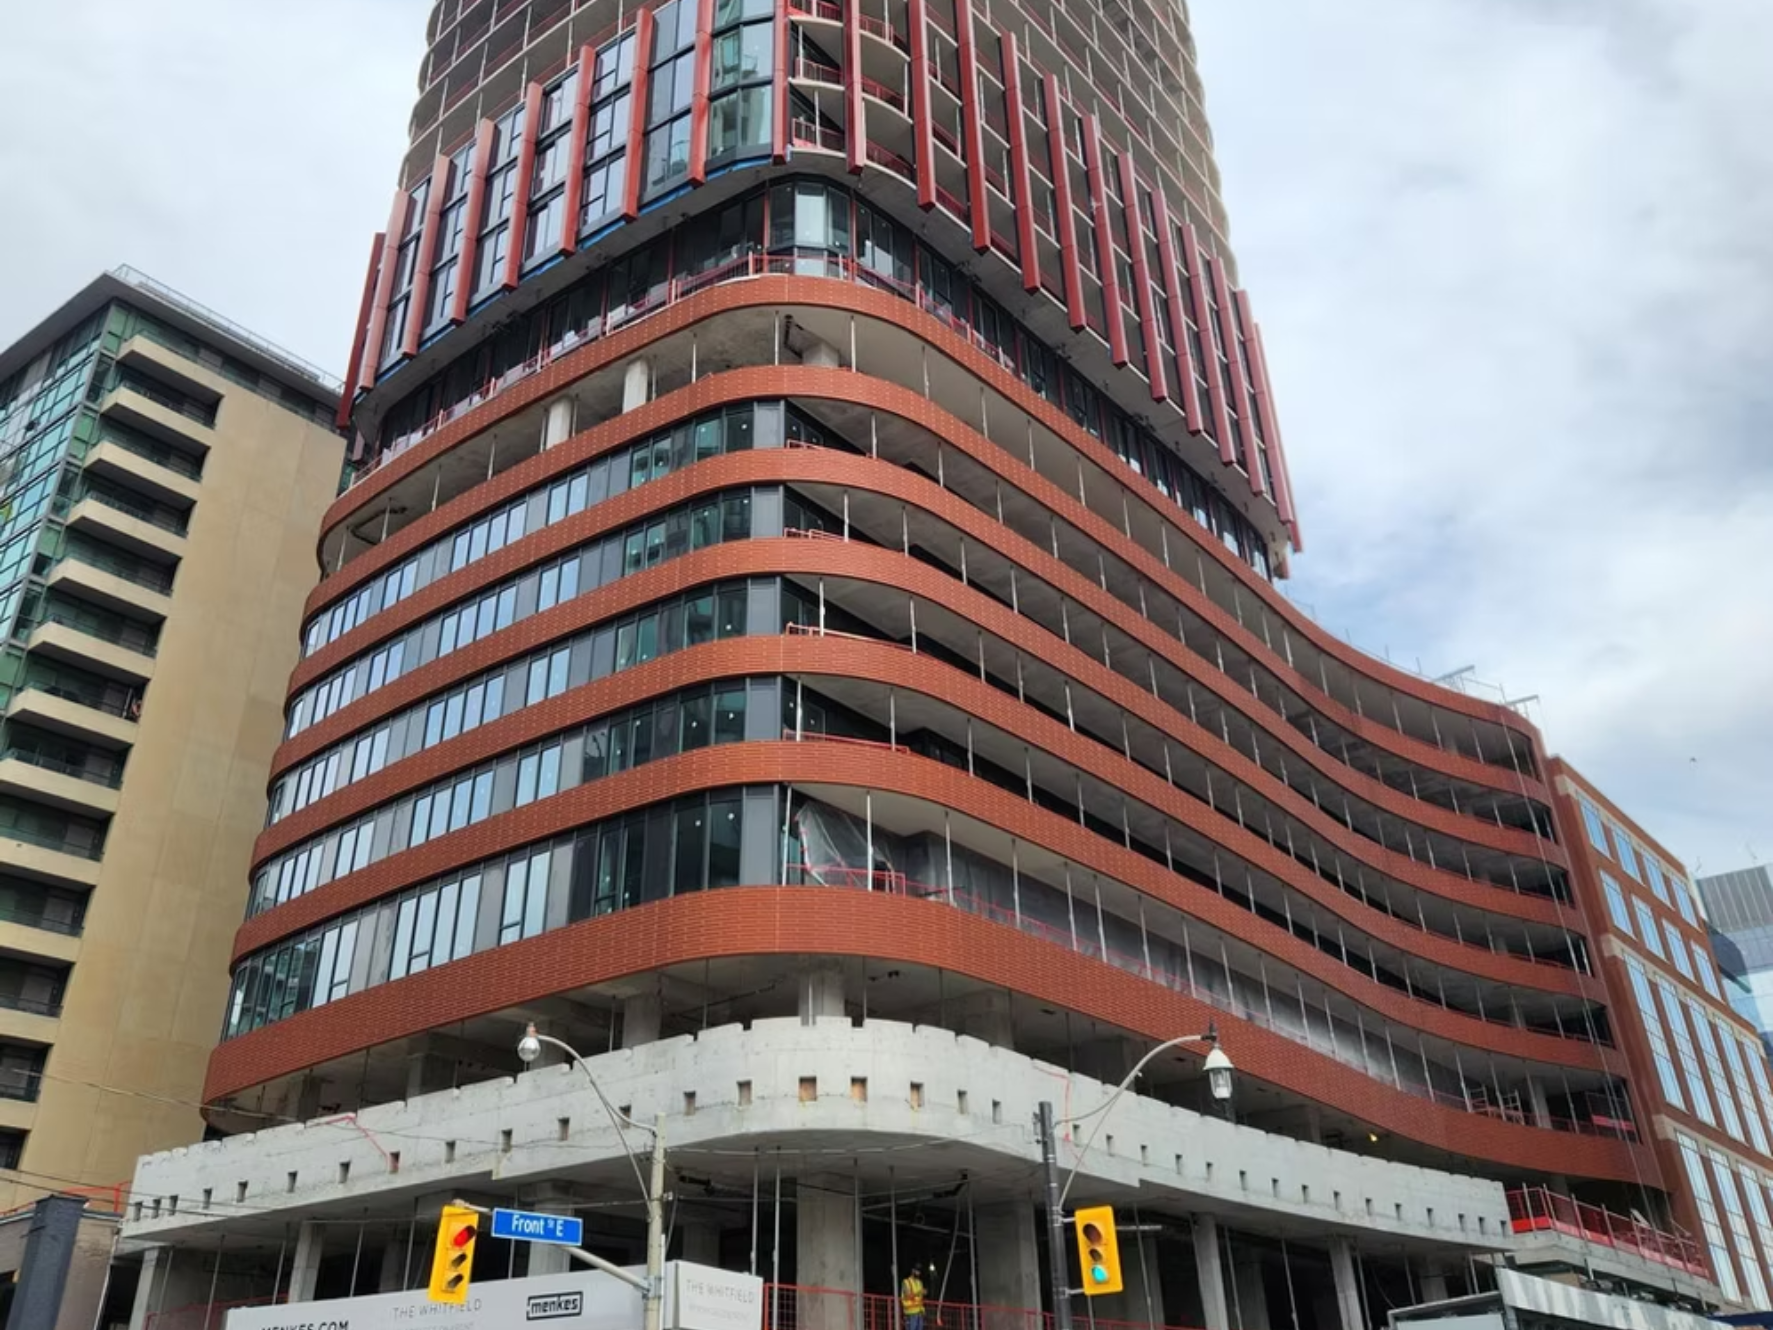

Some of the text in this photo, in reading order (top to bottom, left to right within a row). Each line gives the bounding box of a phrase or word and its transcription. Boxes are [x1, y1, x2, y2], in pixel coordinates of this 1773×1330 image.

[511, 1214, 545, 1236] Front
[556, 1220, 565, 1238] E
[686, 1279, 704, 1296] THE
[392, 1305, 415, 1320] THE
[530, 1295, 579, 1314] menkes
